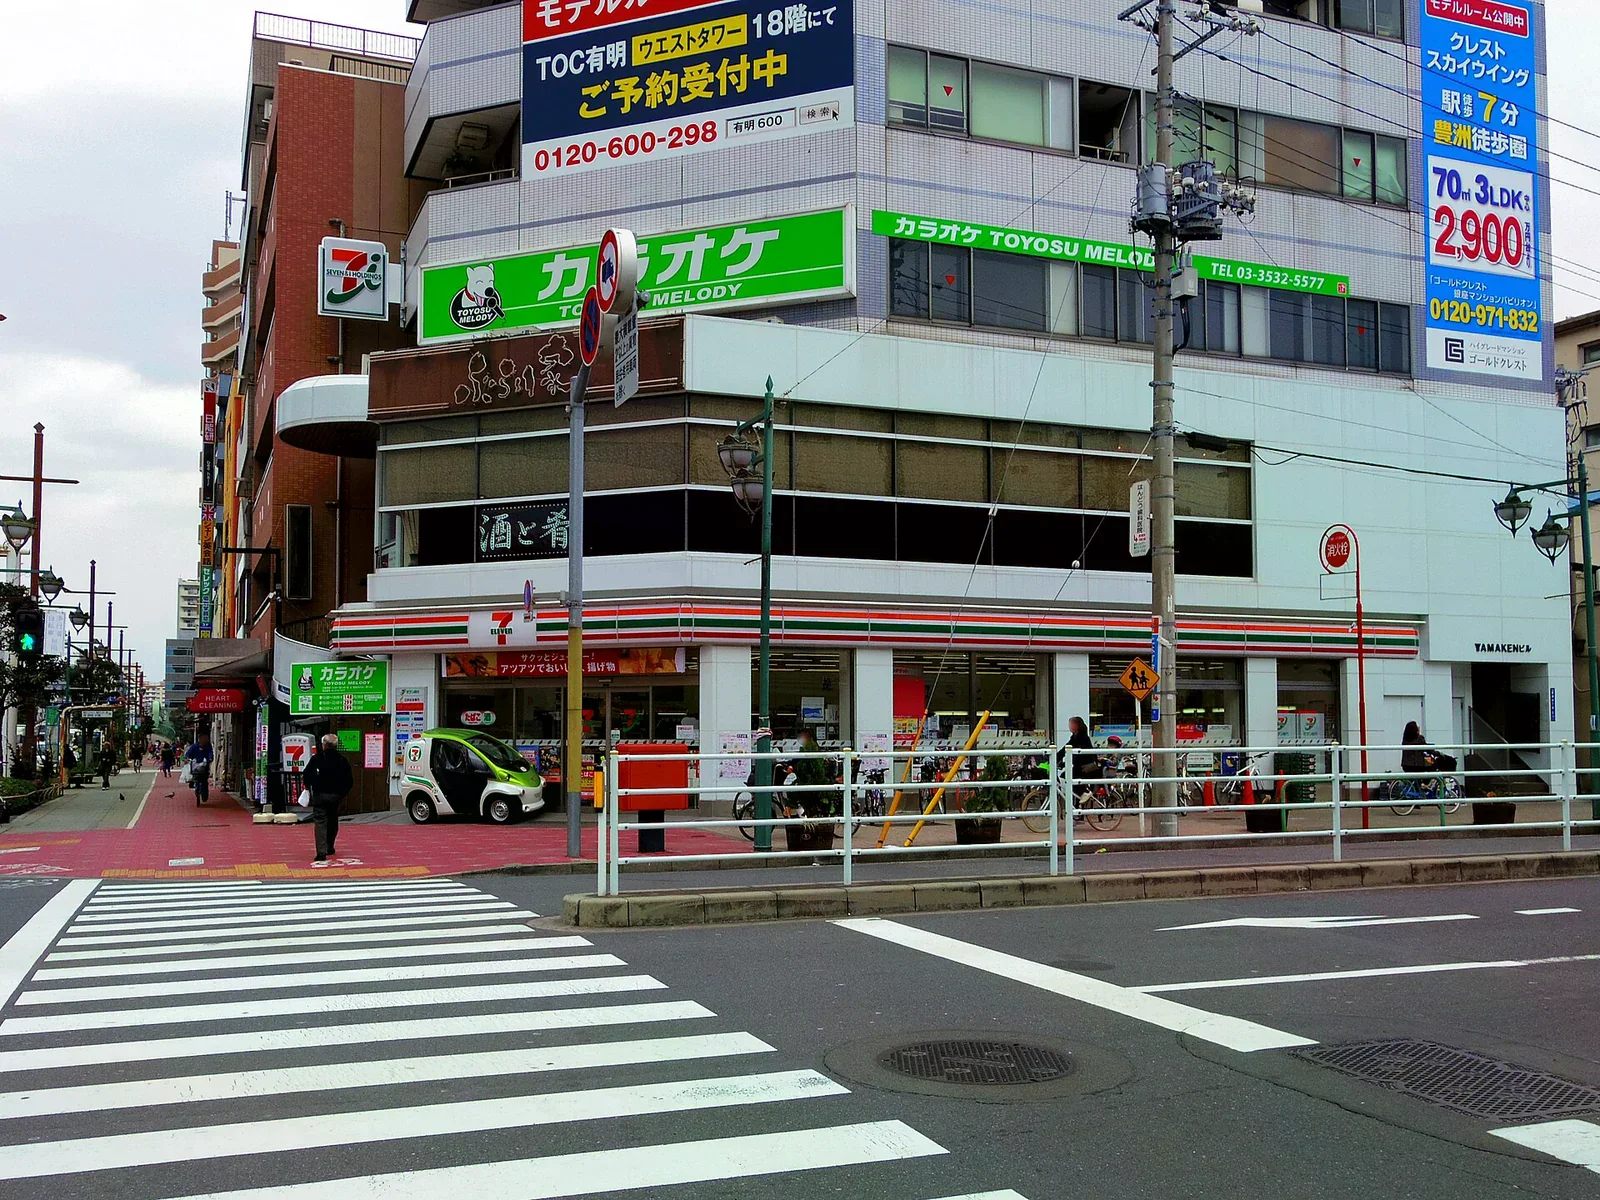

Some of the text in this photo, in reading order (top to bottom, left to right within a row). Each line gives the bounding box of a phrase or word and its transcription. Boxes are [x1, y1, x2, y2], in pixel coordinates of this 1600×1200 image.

[535, 5, 838, 81] TOC有明 ウエストタワー 18階にて
[1449, 31, 1506, 60] クレスト
[578, 49, 788, 119] ご予約受付中
[1426, 49, 1530, 87] スカイウイング
[534, 119, 718, 172] 0120-600-298
[1433, 119, 1528, 160] 豊洲徒歩圏
[893, 216, 1155, 270] カラオケ TOYOSU MELOD
[1434, 204, 1524, 267] 2,900
[537, 227, 780, 301] カオケ
[1211, 262, 1234, 278] TEL
[1236, 266, 1326, 290] 03-3532-5577
[457, 306, 491, 317] TOYOSU
[652, 283, 743, 306] MELODY
[458, 313, 494, 324] MELODY
[1430, 297, 1538, 333] 0120-971-832
[1469, 354, 1527, 371] ゴールドクレスト
[479, 507, 570, 553] 酒と肴
[1327, 541, 1348, 558] 消火栓
[320, 665, 377, 681] カラオケ
